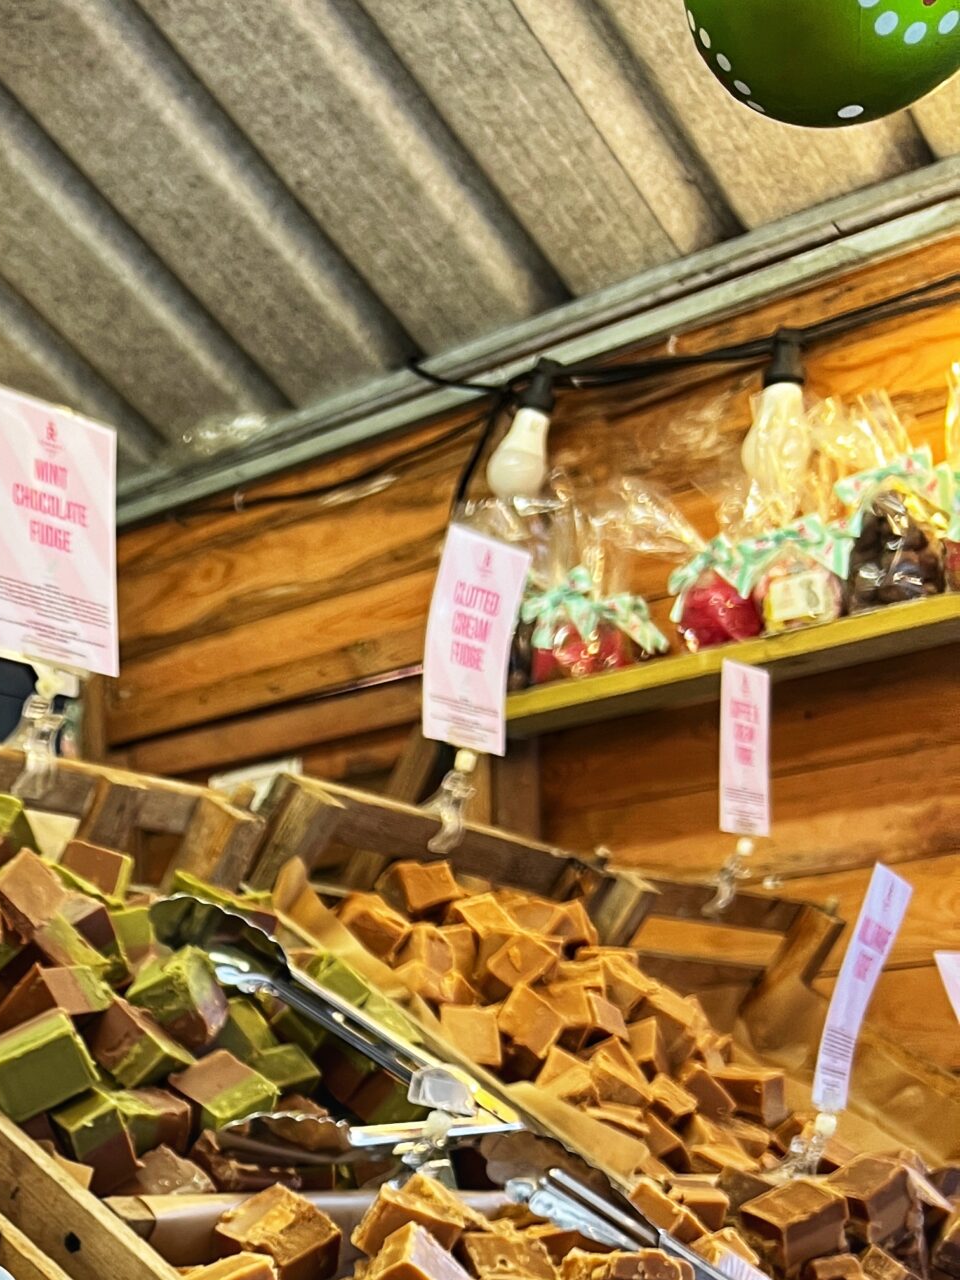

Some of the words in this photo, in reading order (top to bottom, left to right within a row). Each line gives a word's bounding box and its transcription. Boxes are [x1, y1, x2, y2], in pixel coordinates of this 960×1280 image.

[12, 482, 88, 528] CHOCOLATE
[30, 519, 71, 553] FUDGE
[453, 579, 501, 617] CLOTTED
[452, 610, 492, 643] CREAM
